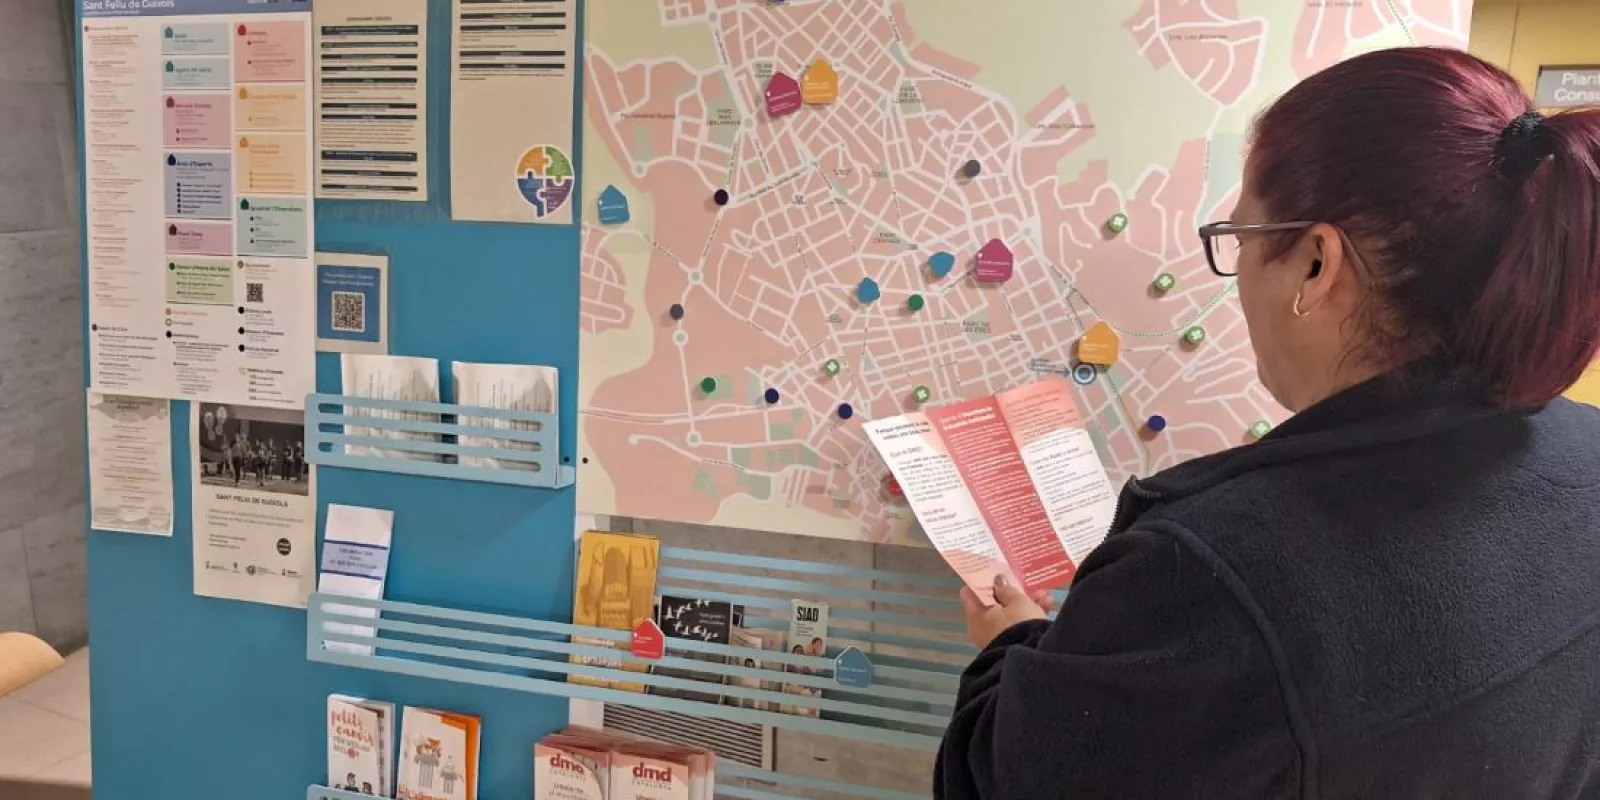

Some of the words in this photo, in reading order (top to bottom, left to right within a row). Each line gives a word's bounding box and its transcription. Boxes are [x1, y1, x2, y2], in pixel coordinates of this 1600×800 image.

[83, 0, 103, 10] Sant
[128, 0, 140, 8] de
[796, 605, 819, 622] SIAD
[632, 762, 672, 782] dmd
